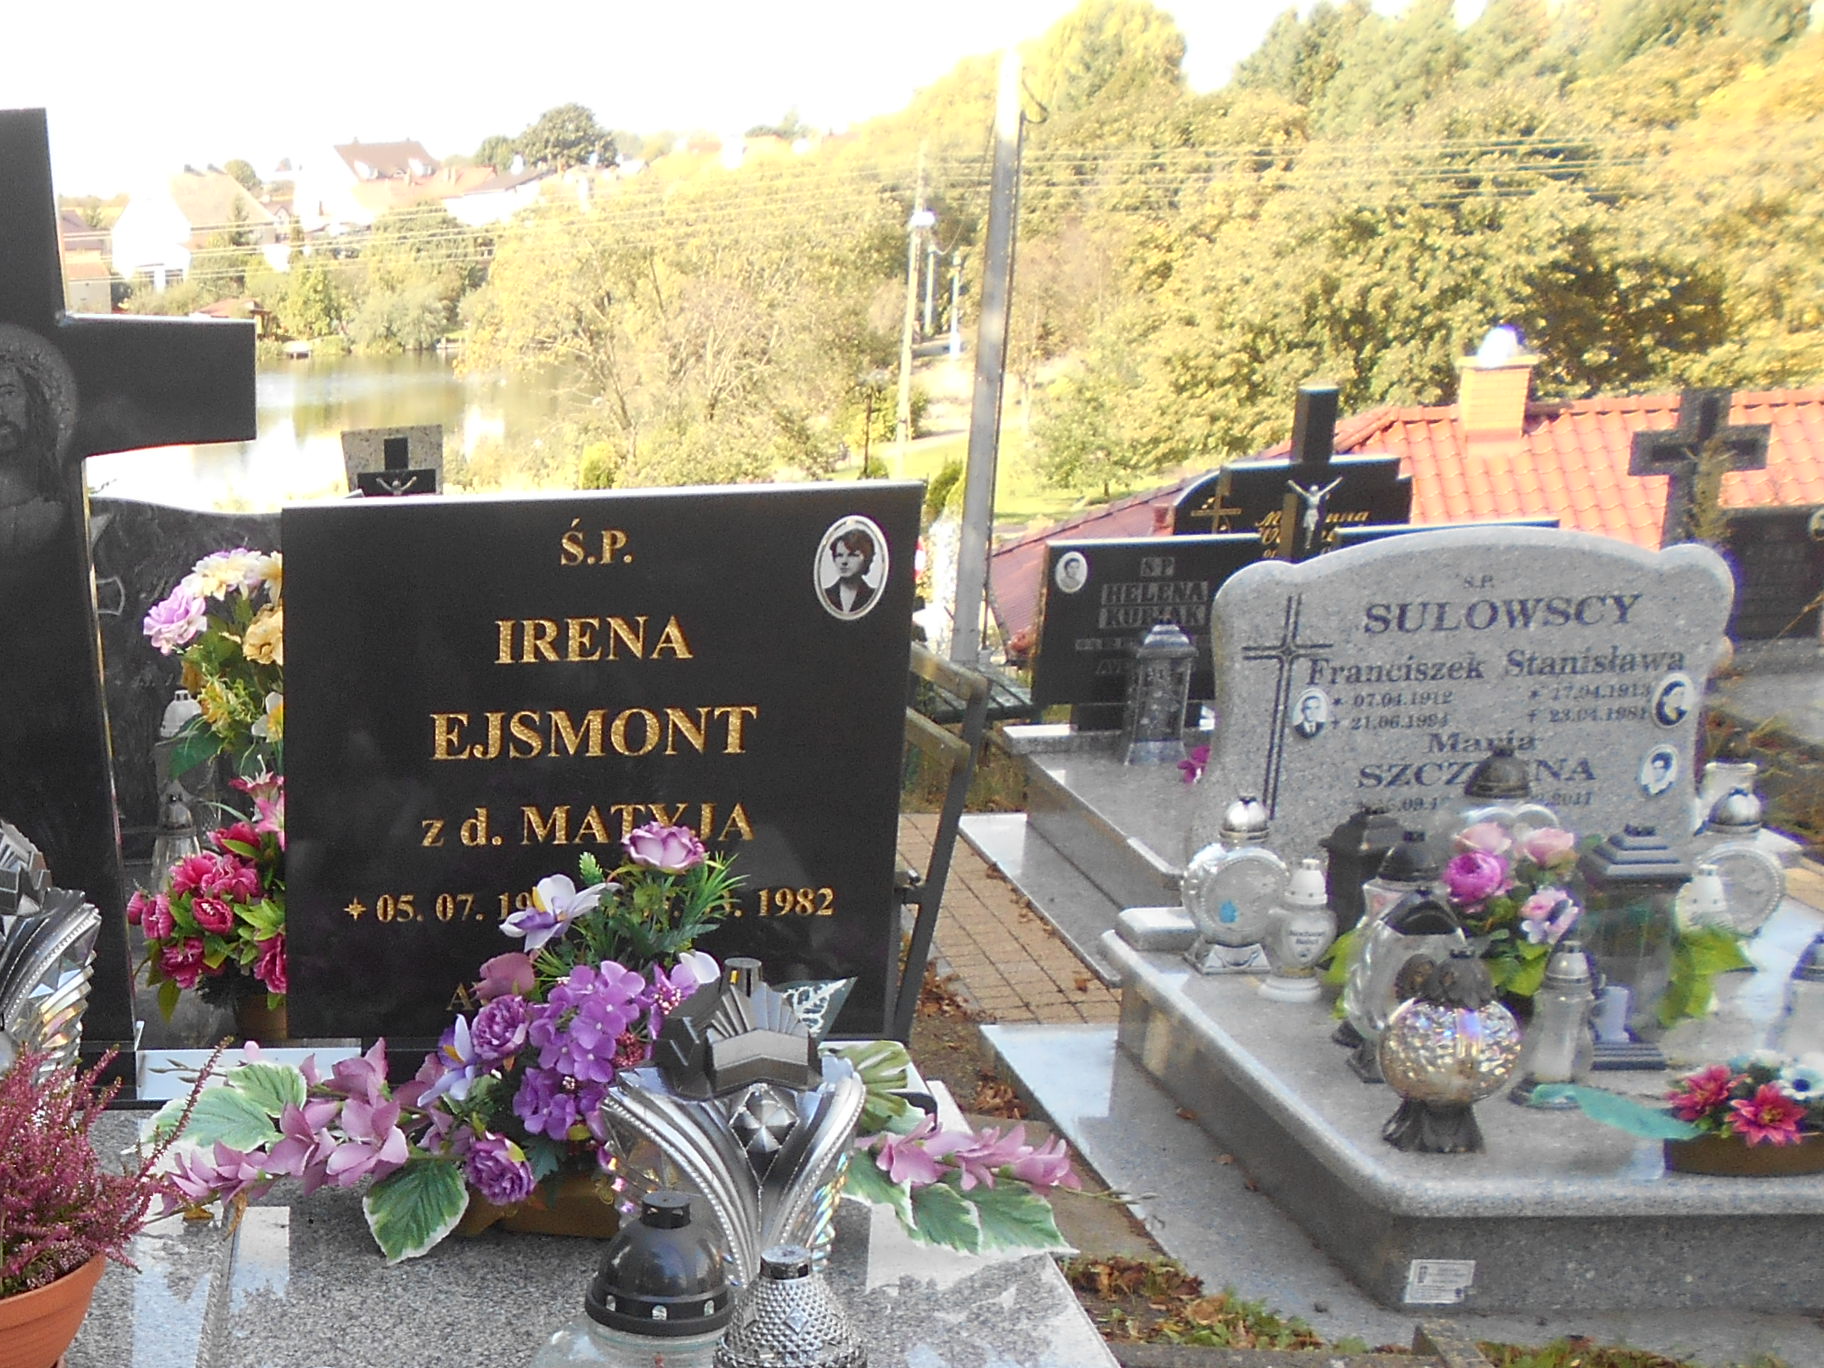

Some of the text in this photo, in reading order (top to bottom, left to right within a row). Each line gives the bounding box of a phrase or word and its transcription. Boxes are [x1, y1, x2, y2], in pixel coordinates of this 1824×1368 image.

[560, 518, 634, 567] Ś.P.
[495, 616, 695, 666] IRENA
[1305, 644, 1685, 686] Franciszek Stanisława
[431, 706, 759, 761] EJSMONT
[1357, 757, 1597, 789] SZCZNA
[422, 820, 445, 848] z
[460, 808, 504, 848] d.
[758, 887, 836, 917] 1982
